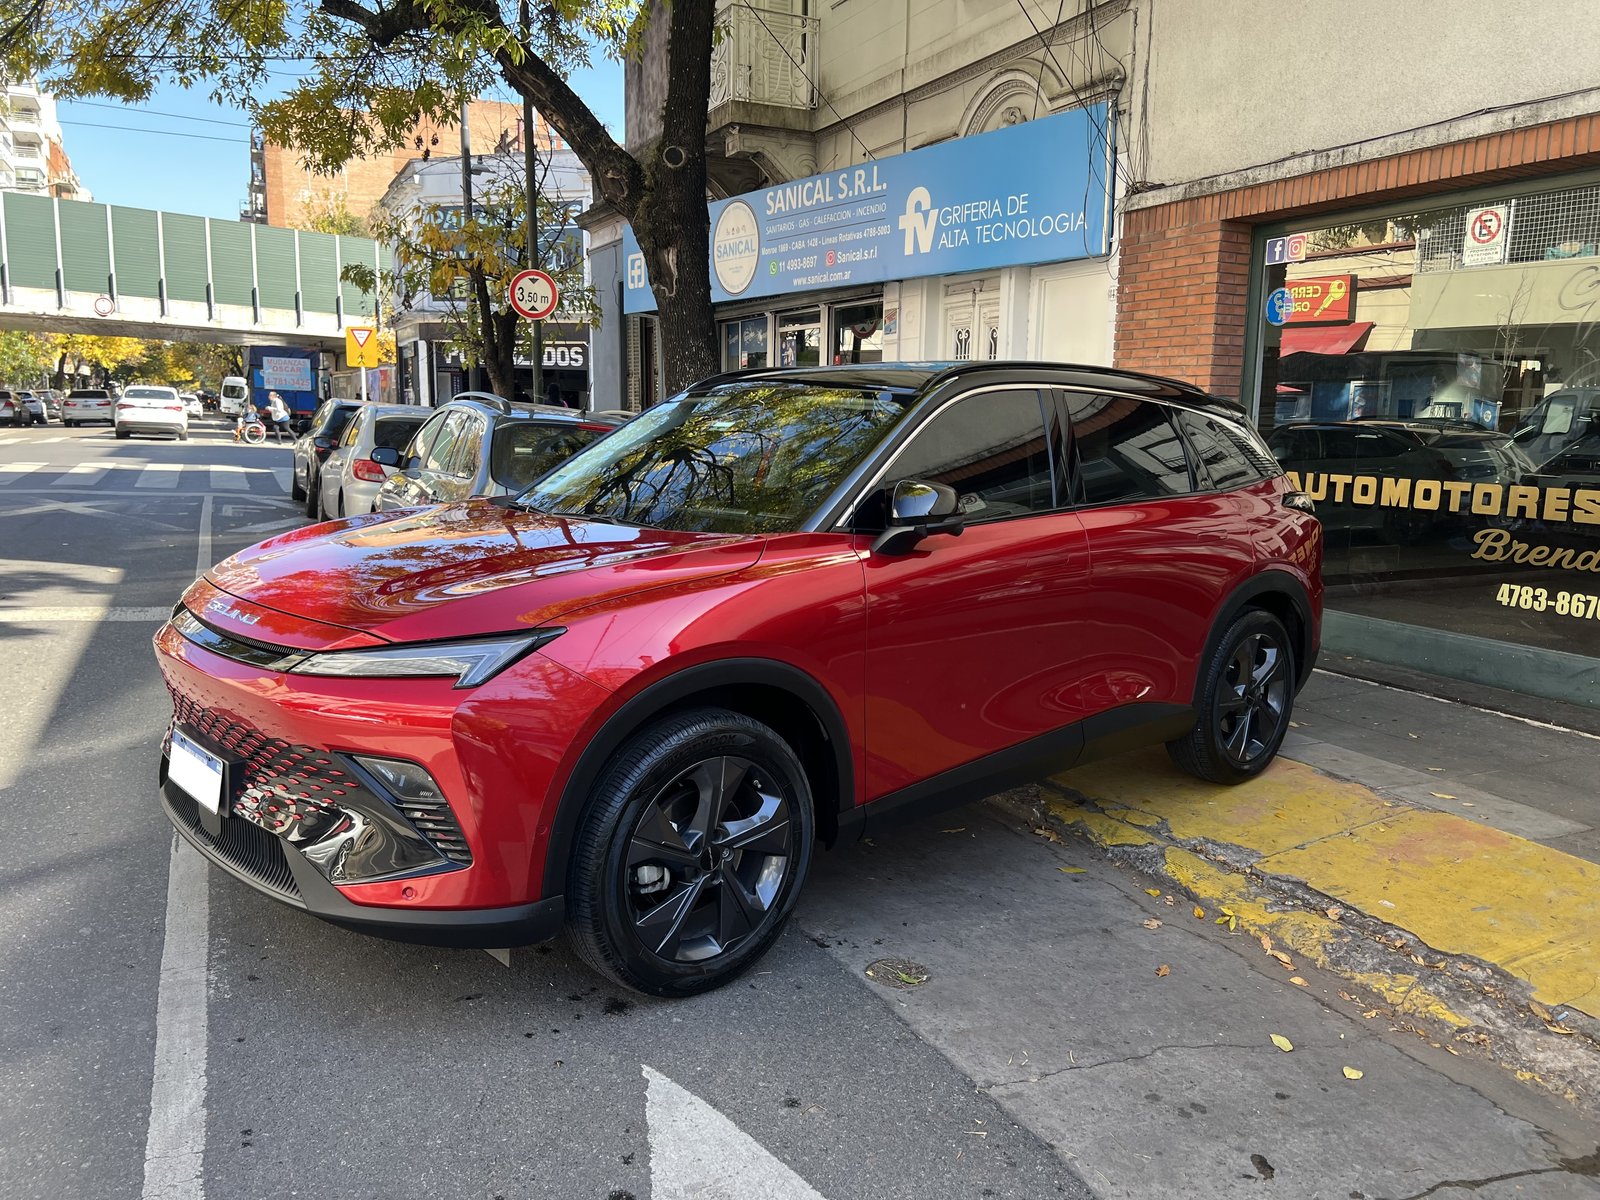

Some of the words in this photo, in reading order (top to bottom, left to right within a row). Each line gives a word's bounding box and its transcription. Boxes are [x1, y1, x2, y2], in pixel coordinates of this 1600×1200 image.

[766, 178, 834, 215] SANICAL
[837, 165, 887, 200] S.R.L.
[765, 221, 795, 235] SANITARIOS
[798, 217, 810, 229] GAS
[856, 202, 887, 216] INCENDIO
[939, 199, 1003, 227] GRIFERIA
[1007, 193, 1029, 216] DE
[791, 240, 806, 251] CABA
[838, 230, 863, 242] Rotativas
[938, 229, 970, 249] ALTA
[975, 211, 1088, 244] TECNOLOGIA
[716, 239, 756, 260] SANICAL
[779, 262, 786, 273] 11
[787, 255, 818, 271] 4993-8697
[792, 270, 852, 287] www.sanical.com.ar
[517, 286, 538, 304] 3,50
[540, 295, 549, 304] m
[271, 365, 302, 373] OSCAR
[1496, 583, 1600, 621] 4783-867
